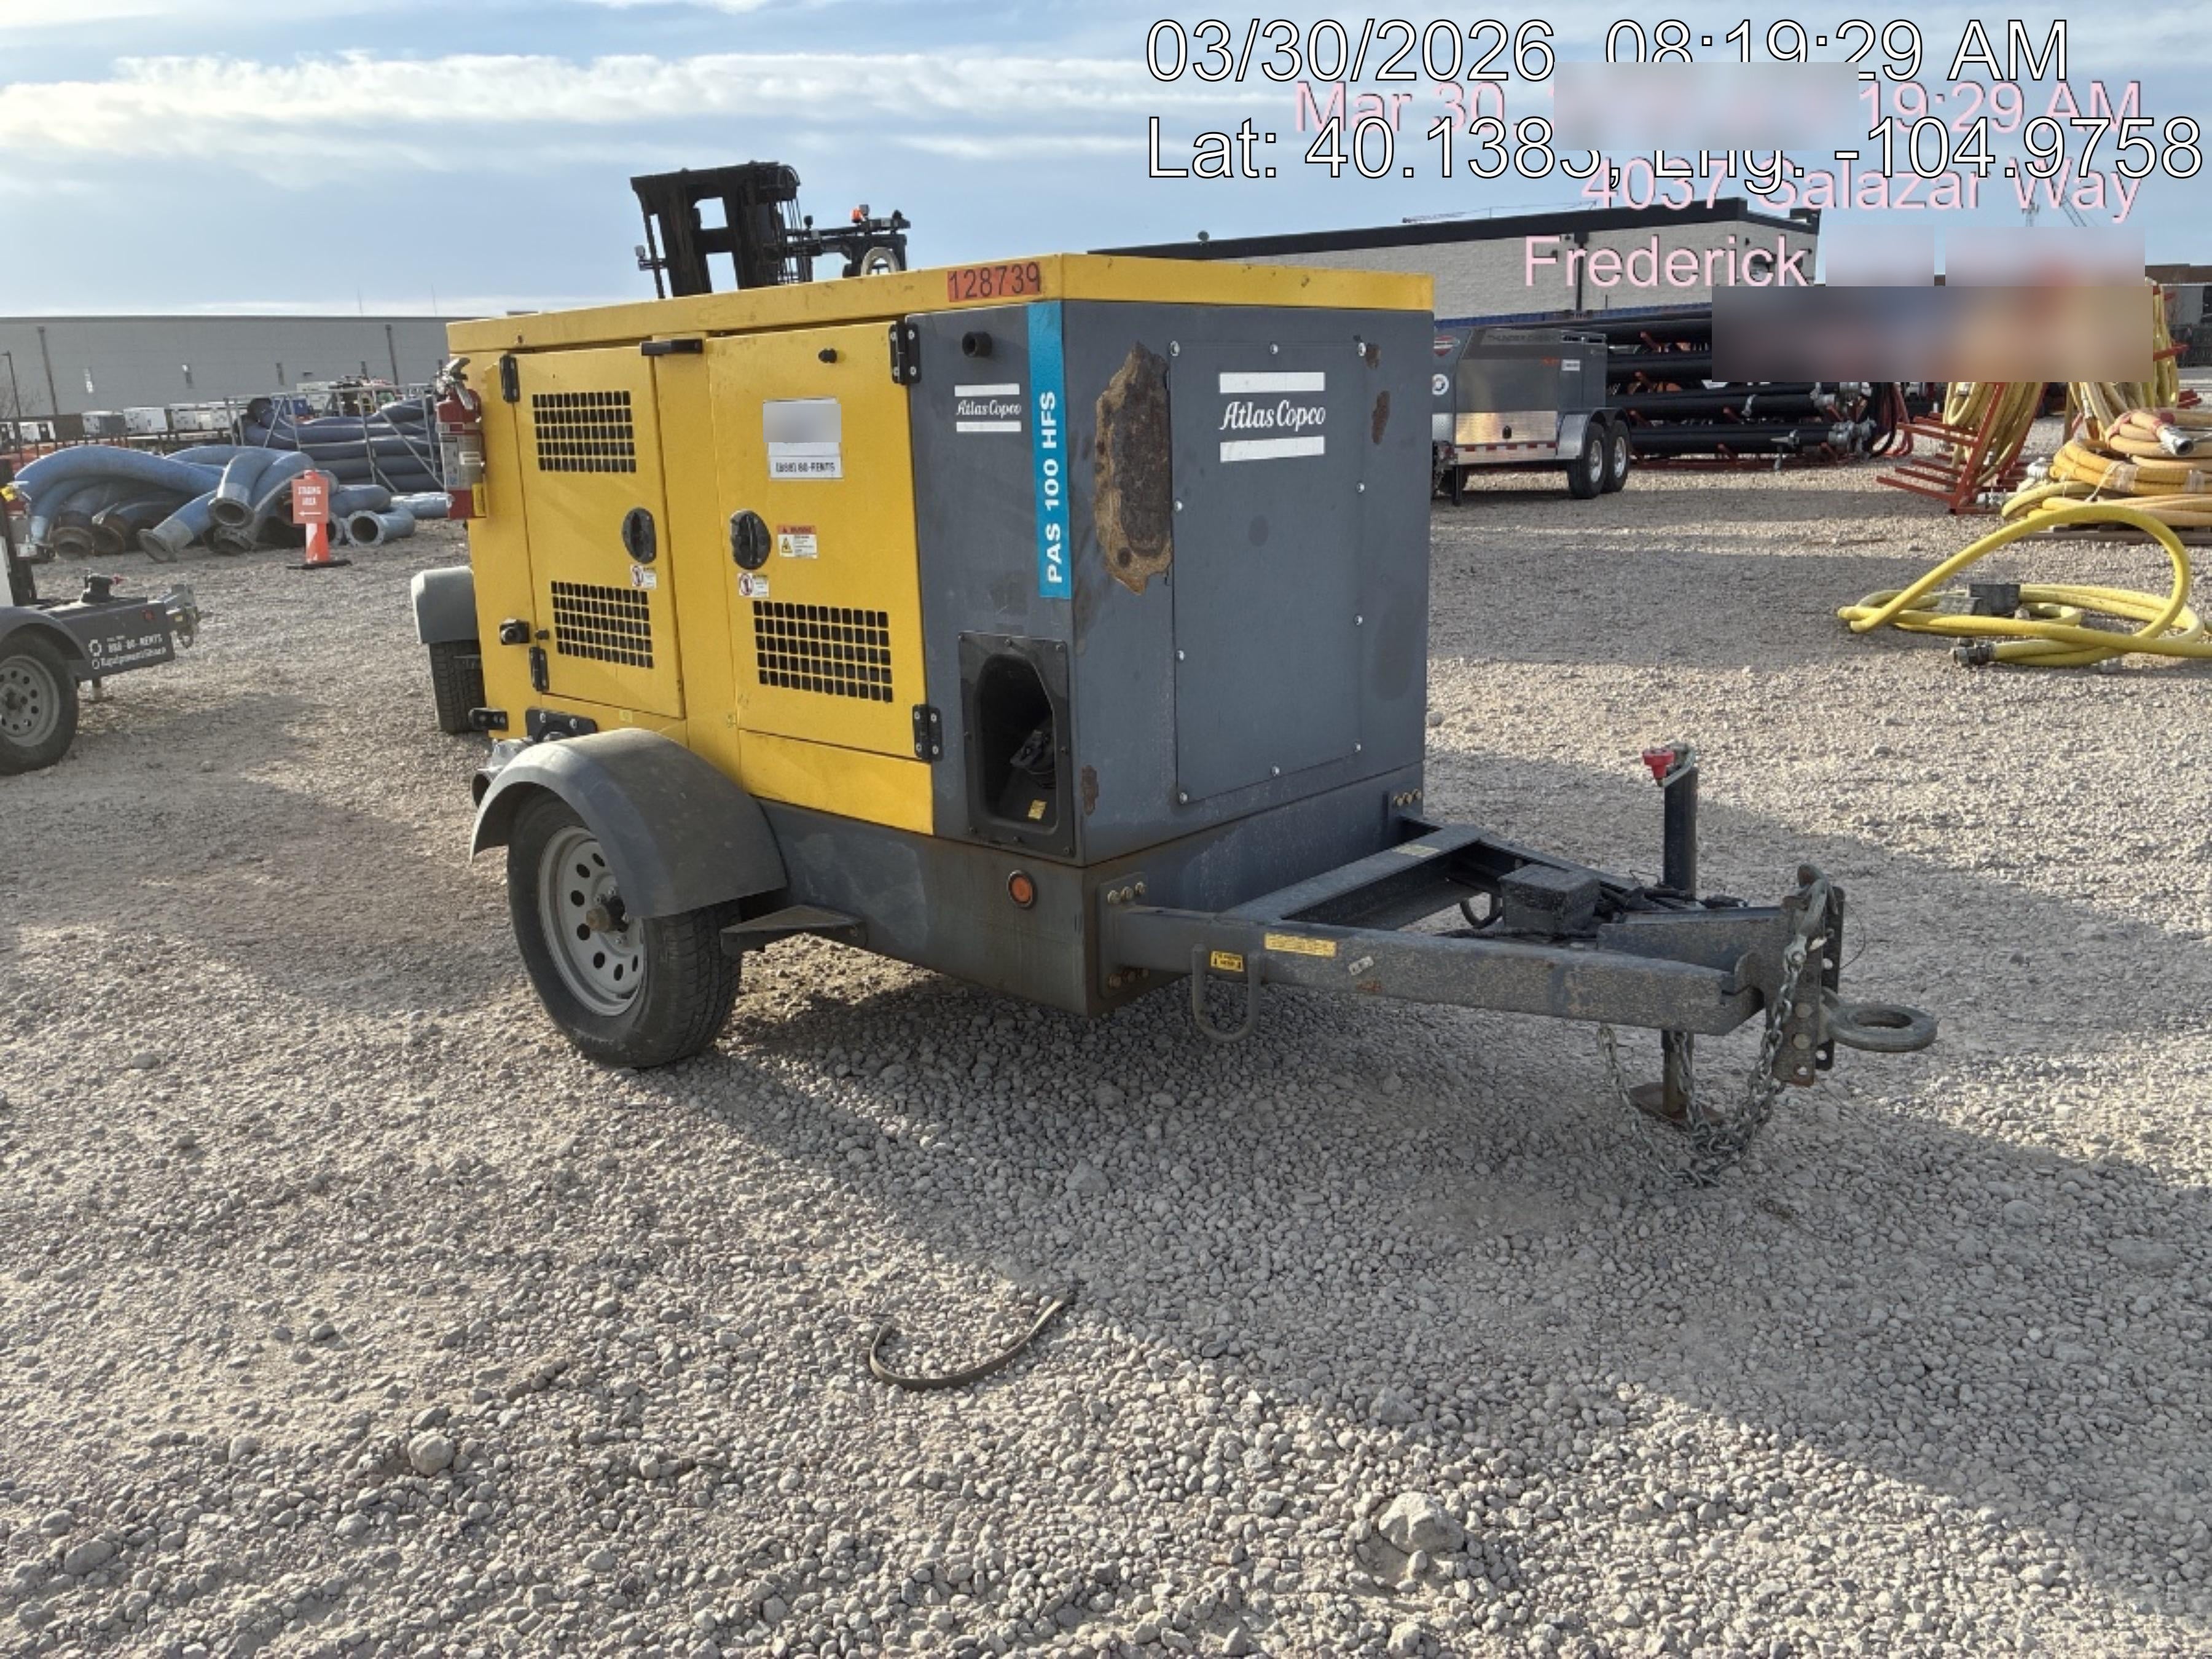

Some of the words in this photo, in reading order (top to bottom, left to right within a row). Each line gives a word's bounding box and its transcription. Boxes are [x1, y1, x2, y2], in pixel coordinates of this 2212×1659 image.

[948, 261, 1041, 299] 128739
[956, 399, 987, 416] Atlas
[989, 399, 1022, 419] Copco
[1040, 391, 1057, 449] HFS
[1219, 401, 1274, 430] Atlas
[1276, 399, 1326, 432] Copco
[1043, 458, 1060, 512] 100
[1046, 523, 1063, 584] PAS
